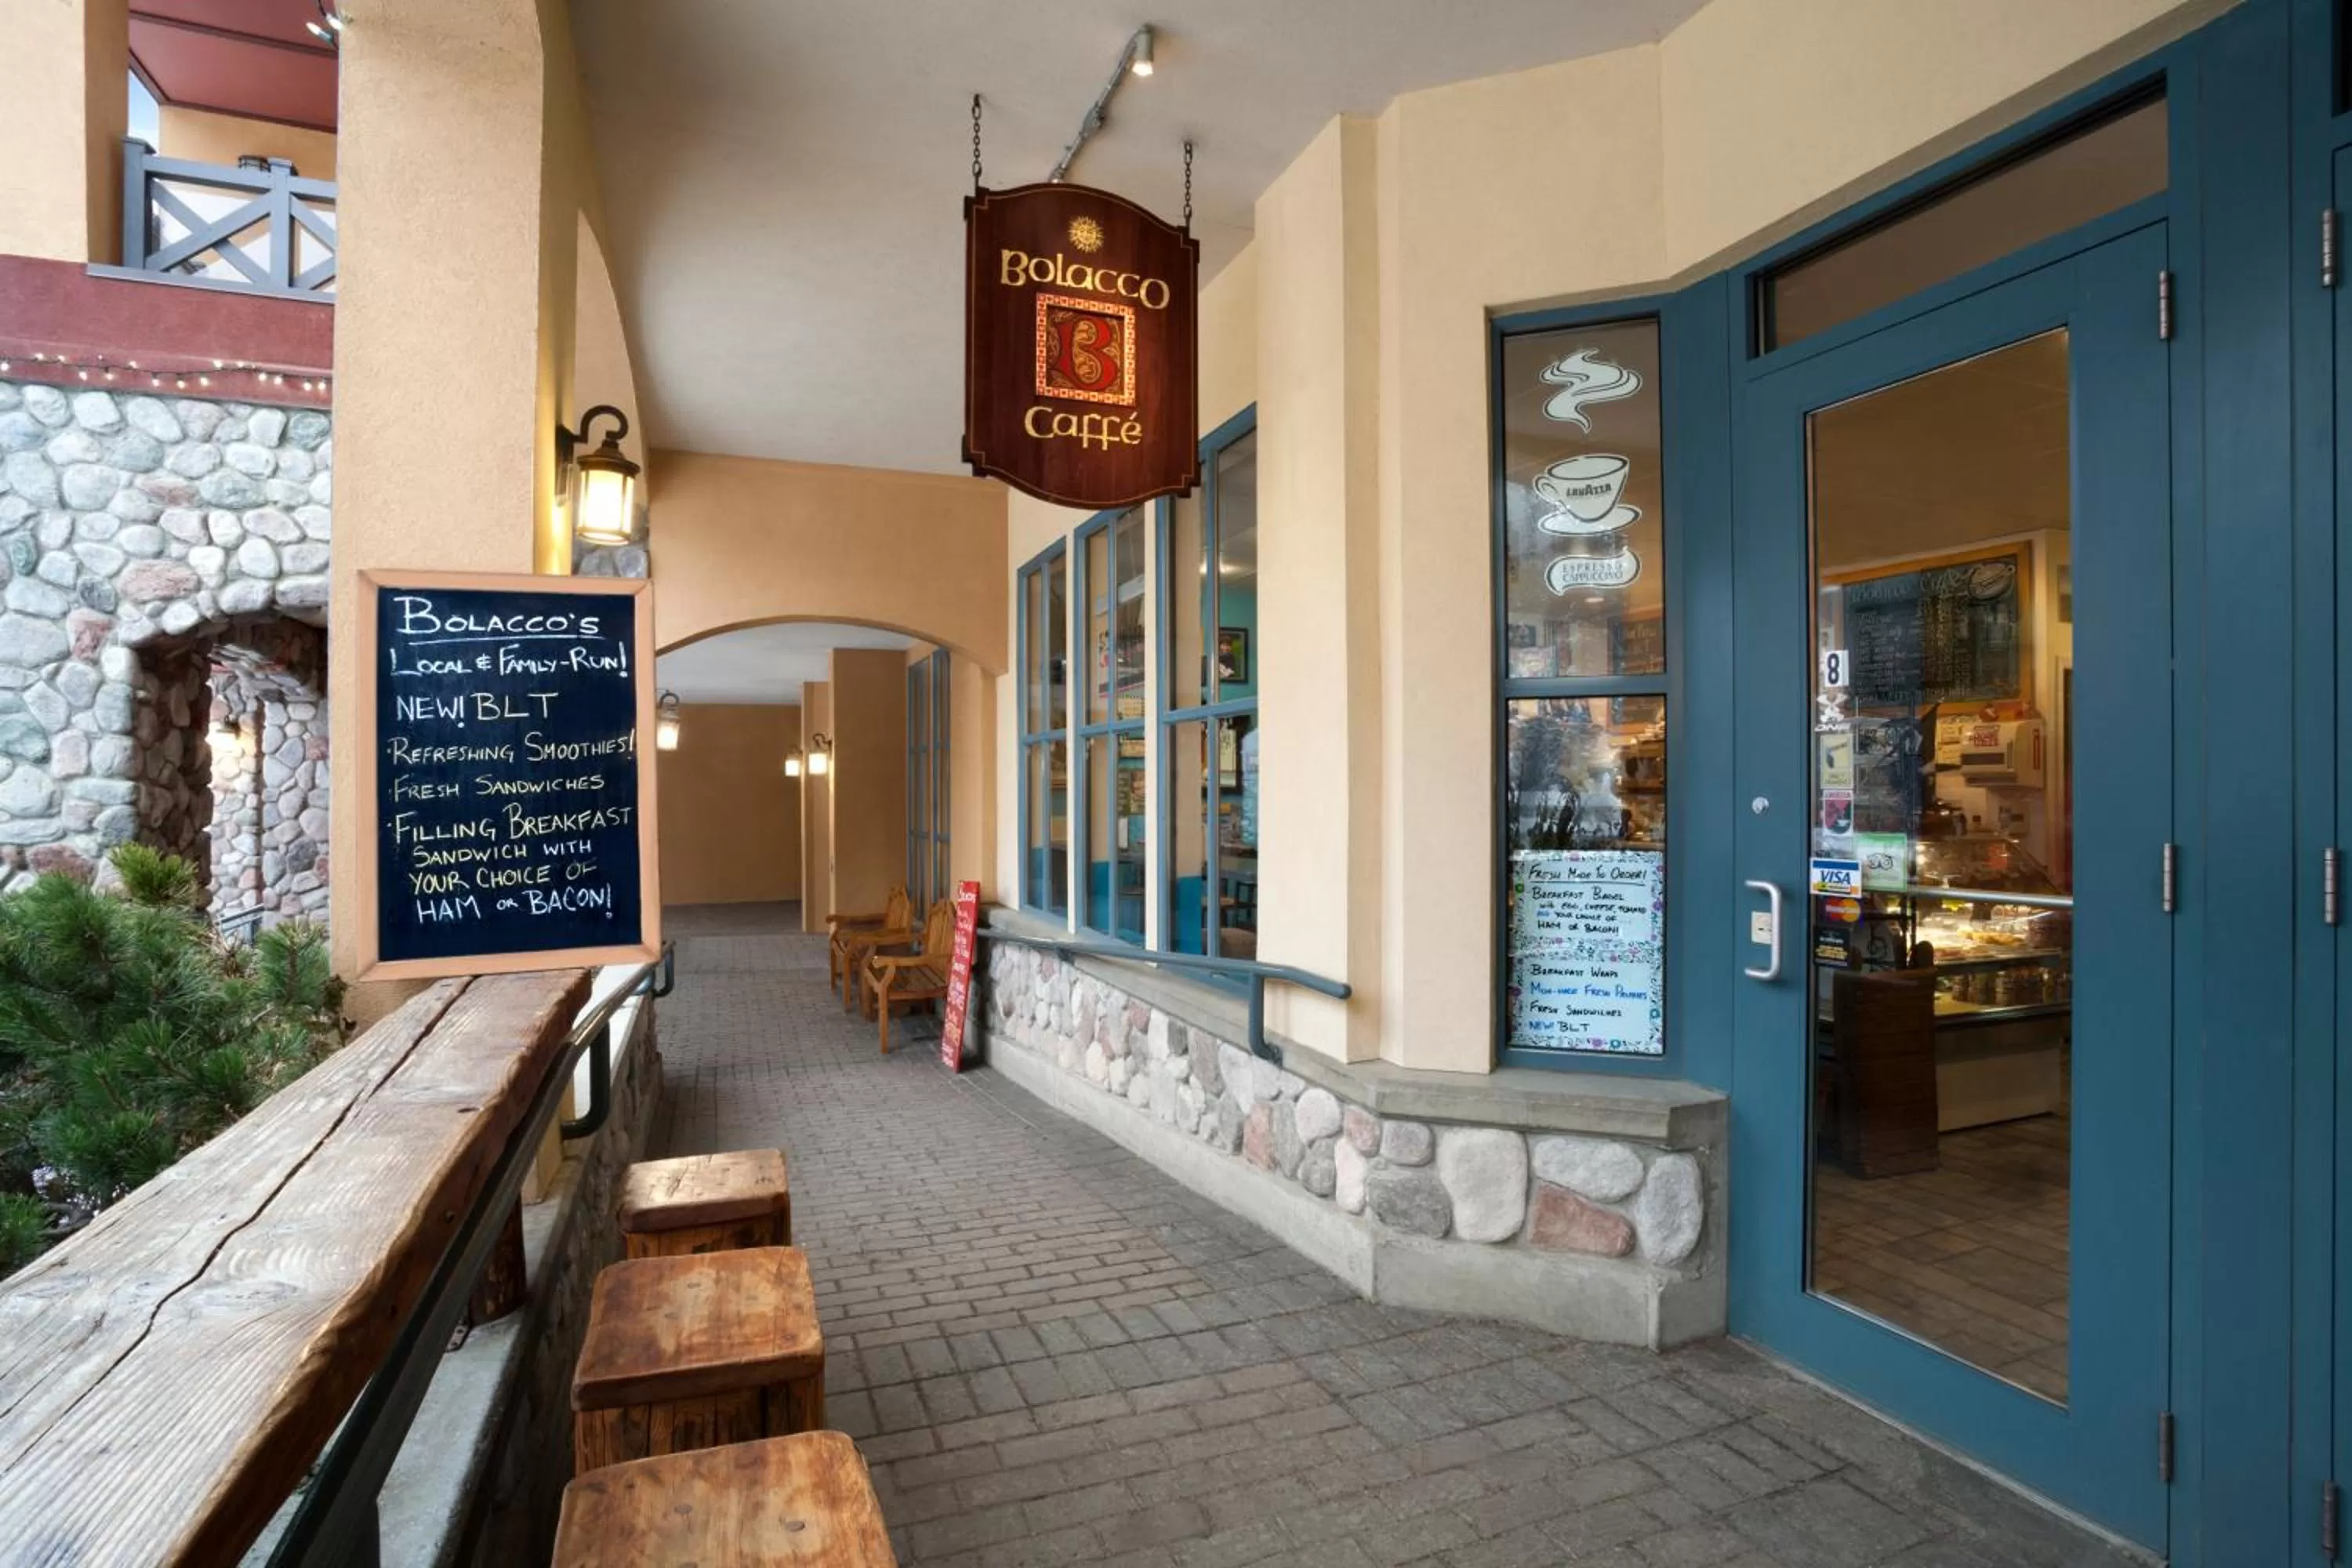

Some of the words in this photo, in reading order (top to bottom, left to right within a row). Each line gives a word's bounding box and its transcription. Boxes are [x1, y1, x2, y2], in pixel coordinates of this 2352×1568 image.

[1025, 405, 1142, 450] Caffé
[1563, 563, 1622, 573] ESPRESSO
[1563, 572, 1623, 583] CAPPUCCINO
[390, 648, 473, 677] LOCAL
[1827, 652, 1840, 685] 8
[396, 695, 465, 728] NEW!
[470, 691, 559, 720] BLT
[389, 736, 515, 765] REFRESHING
[524, 728, 635, 761] SMOOTHIES!
[394, 774, 460, 803] FRESH
[474, 774, 605, 795] SANDWICHES
[396, 811, 496, 844] FILLING
[502, 802, 633, 839] BREAKFAST
[413, 844, 528, 867] SANDWICH
[543, 840, 592, 856] WITH
[408, 871, 470, 895] YOUR
[476, 865, 551, 889] CHOICE
[565, 858, 598, 880] OF
[1819, 869, 1851, 884] VISA
[416, 895, 481, 924] HAM
[521, 882, 613, 920] BACON!
[1557, 1020, 1590, 1033] BLT
